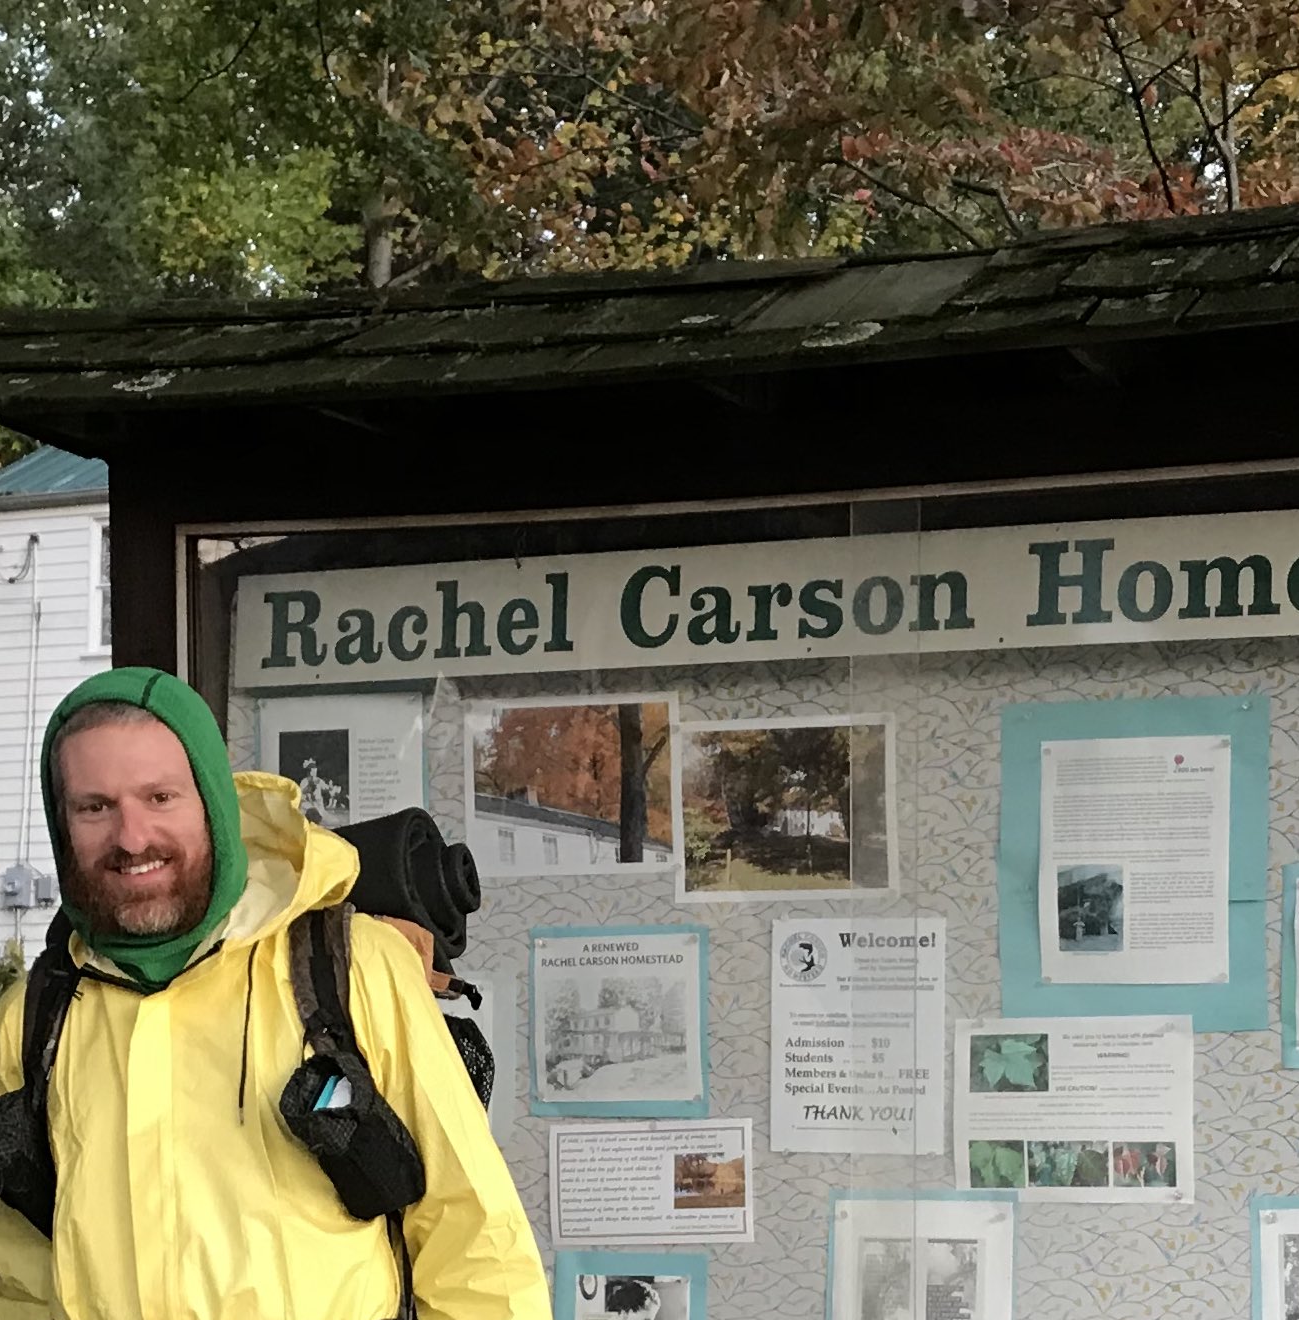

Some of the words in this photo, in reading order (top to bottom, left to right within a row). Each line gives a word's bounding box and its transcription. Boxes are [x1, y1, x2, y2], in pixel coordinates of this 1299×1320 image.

[261, 570, 575, 669] Rachel
[620, 564, 976, 649] Carson
[839, 932, 936, 948] Welcome!
[583, 944, 590, 952] A
[592, 942, 639, 952] RENEWED
[541, 958, 577, 967] RACHEL
[579, 956, 619, 966] CARSON
[621, 954, 683, 965] HOMESTEAD
[785, 1037, 844, 1048] Admission
[785, 1052, 833, 1063] Students
[785, 1068, 837, 1078] Members
[839, 1069, 847, 1078] &
[898, 1069, 930, 1080] FREE
[784, 1083, 824, 1096] Special
[803, 1105, 864, 1121] THANK
[869, 1106, 914, 1121] YOU!
